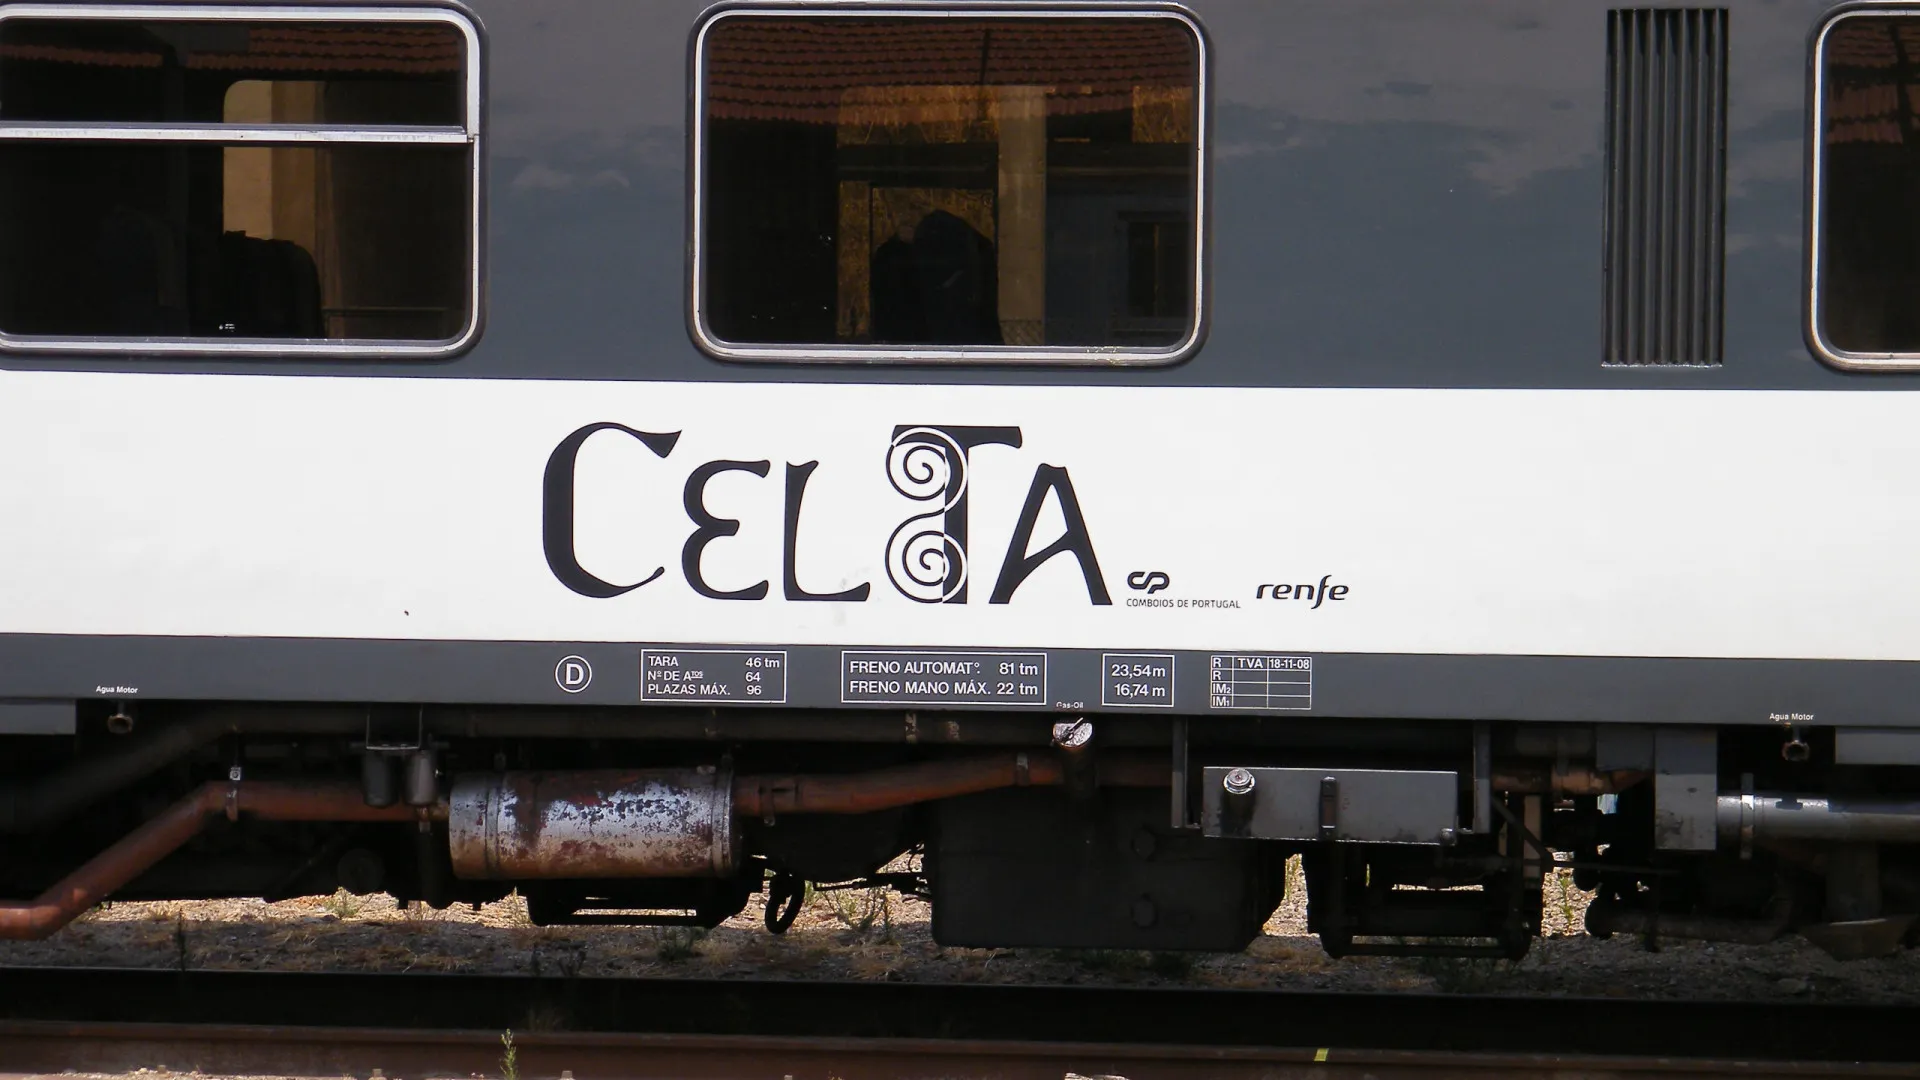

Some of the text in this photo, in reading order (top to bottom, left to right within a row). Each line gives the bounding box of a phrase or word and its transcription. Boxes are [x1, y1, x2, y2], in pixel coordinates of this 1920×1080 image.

[1256, 574, 1349, 610] renfe
[1126, 598, 1241, 609] COMBOIOS DE PORTUGAL
[648, 655, 780, 668] TARA 46 tm
[850, 661, 901, 674] FRENO
[999, 662, 1015, 675] 81
[1019, 662, 1038, 675] tm
[1212, 657, 1310, 670] R TVA 18-11-08
[565, 663, 585, 685] D
[663, 670, 681, 681] DE
[745, 671, 761, 682] 64
[1212, 670, 1222, 681] R
[95, 685, 139, 695] Agua Motor
[647, 682, 762, 696] PLAZAS MÁX. 96
[850, 679, 1038, 696] FRENO MANO MÁX. 22 tm
[1114, 683, 1149, 699] 16,74
[1769, 712, 1814, 722] Agua Motor
